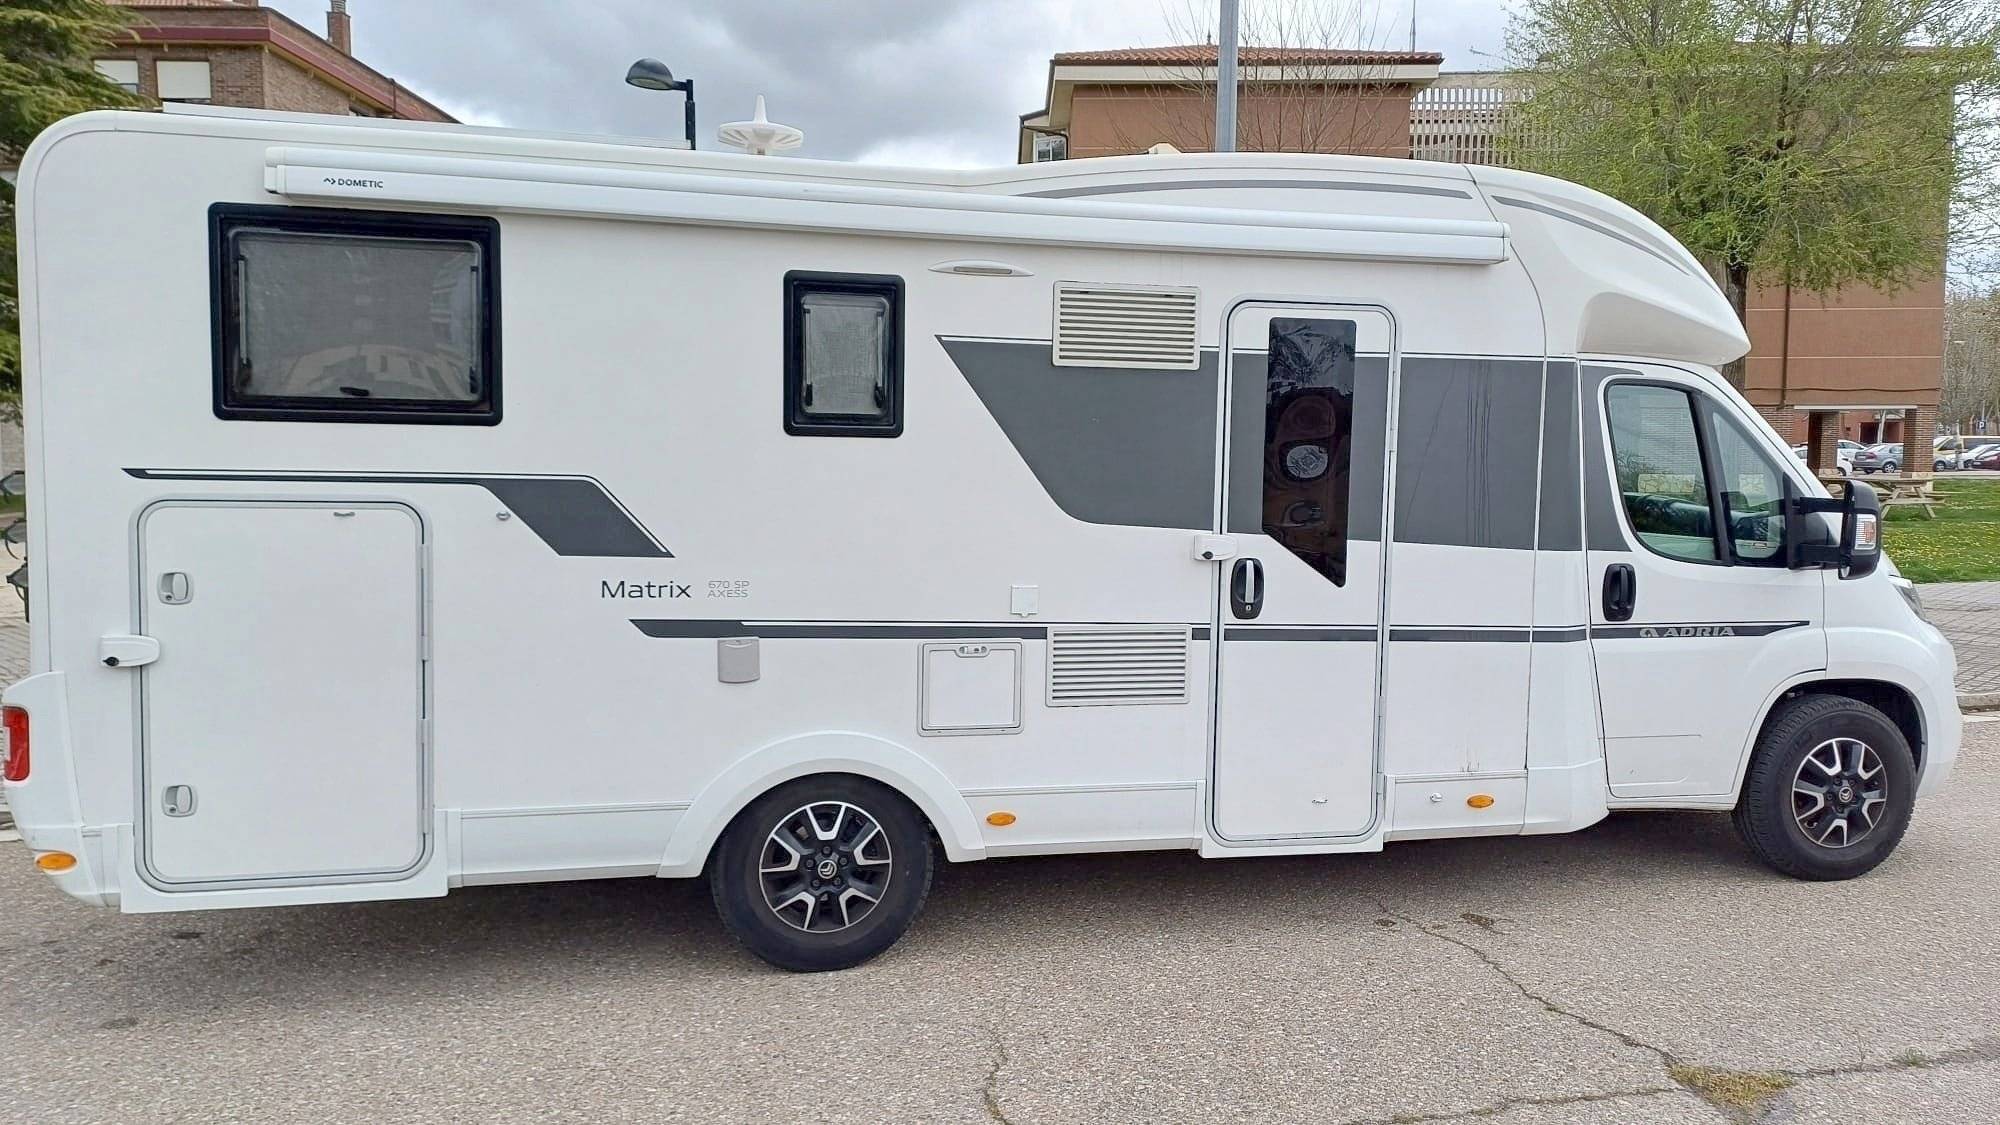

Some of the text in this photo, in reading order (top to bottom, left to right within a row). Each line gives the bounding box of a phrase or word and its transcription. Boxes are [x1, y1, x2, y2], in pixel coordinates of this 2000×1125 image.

[338, 178, 384, 188] DOMETIC
[601, 580, 692, 598] Matrix
[708, 580, 750, 589] 670 SP
[707, 589, 749, 598] AXESS
[1664, 626, 1735, 637] ADRIA
